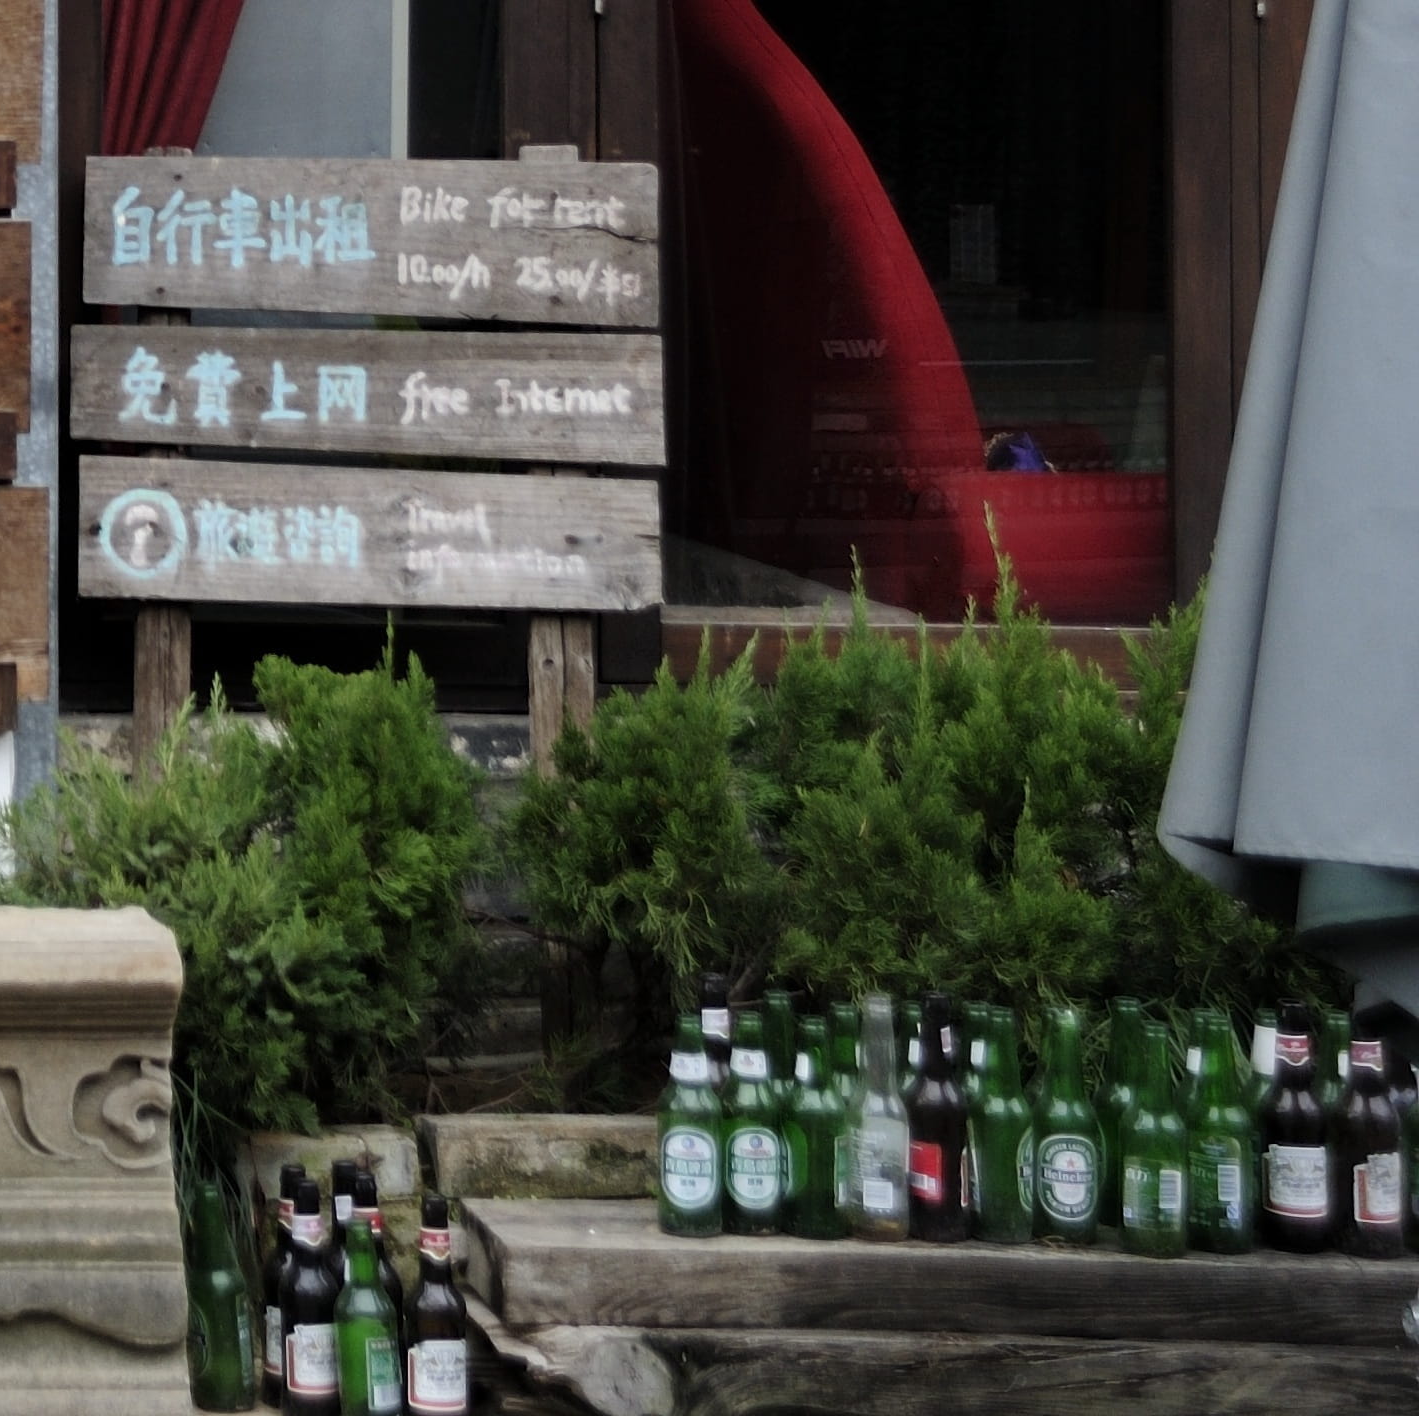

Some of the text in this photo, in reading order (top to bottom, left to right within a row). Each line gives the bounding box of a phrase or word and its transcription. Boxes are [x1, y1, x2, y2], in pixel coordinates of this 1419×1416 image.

[110, 185, 376, 268] 自行車出租
[399, 186, 468, 227] Bike
